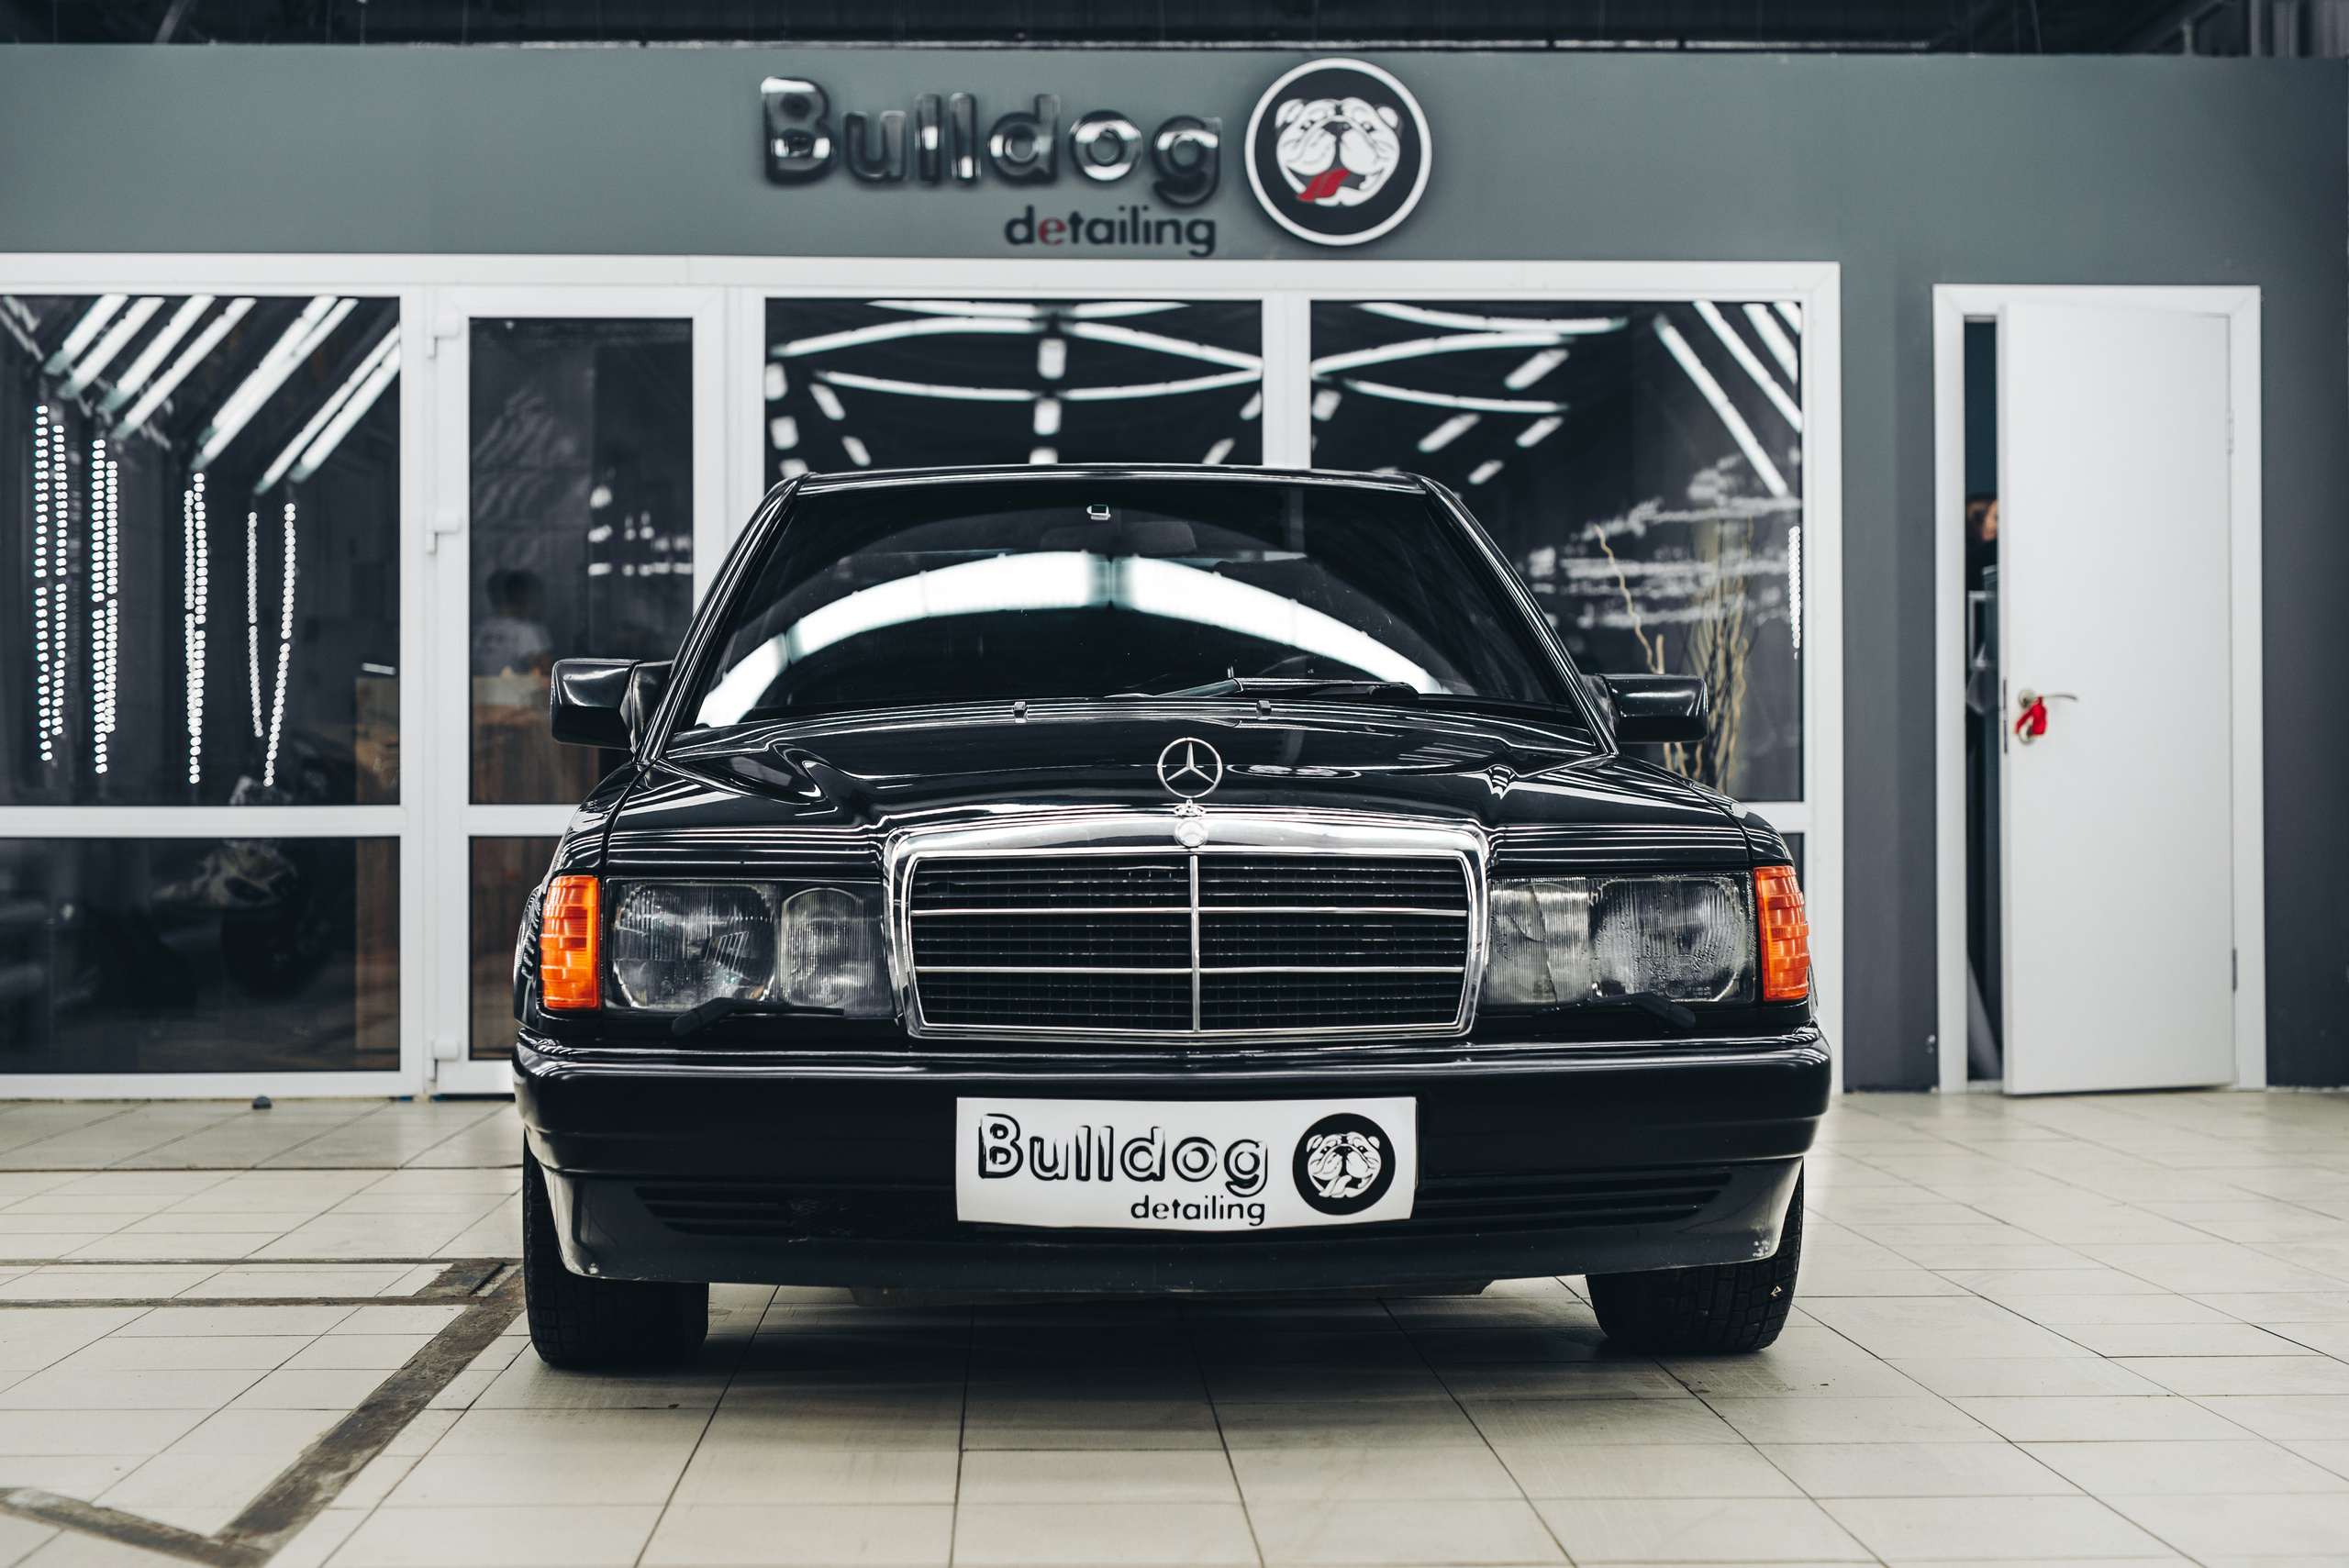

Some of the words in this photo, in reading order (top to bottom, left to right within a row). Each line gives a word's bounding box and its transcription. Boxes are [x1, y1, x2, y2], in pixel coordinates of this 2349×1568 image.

[761, 76, 1222, 206] Bulldog
[1005, 205, 1217, 257] detailing
[978, 1113, 1268, 1197] Bulldog
[1130, 1195, 1265, 1227] detailing
